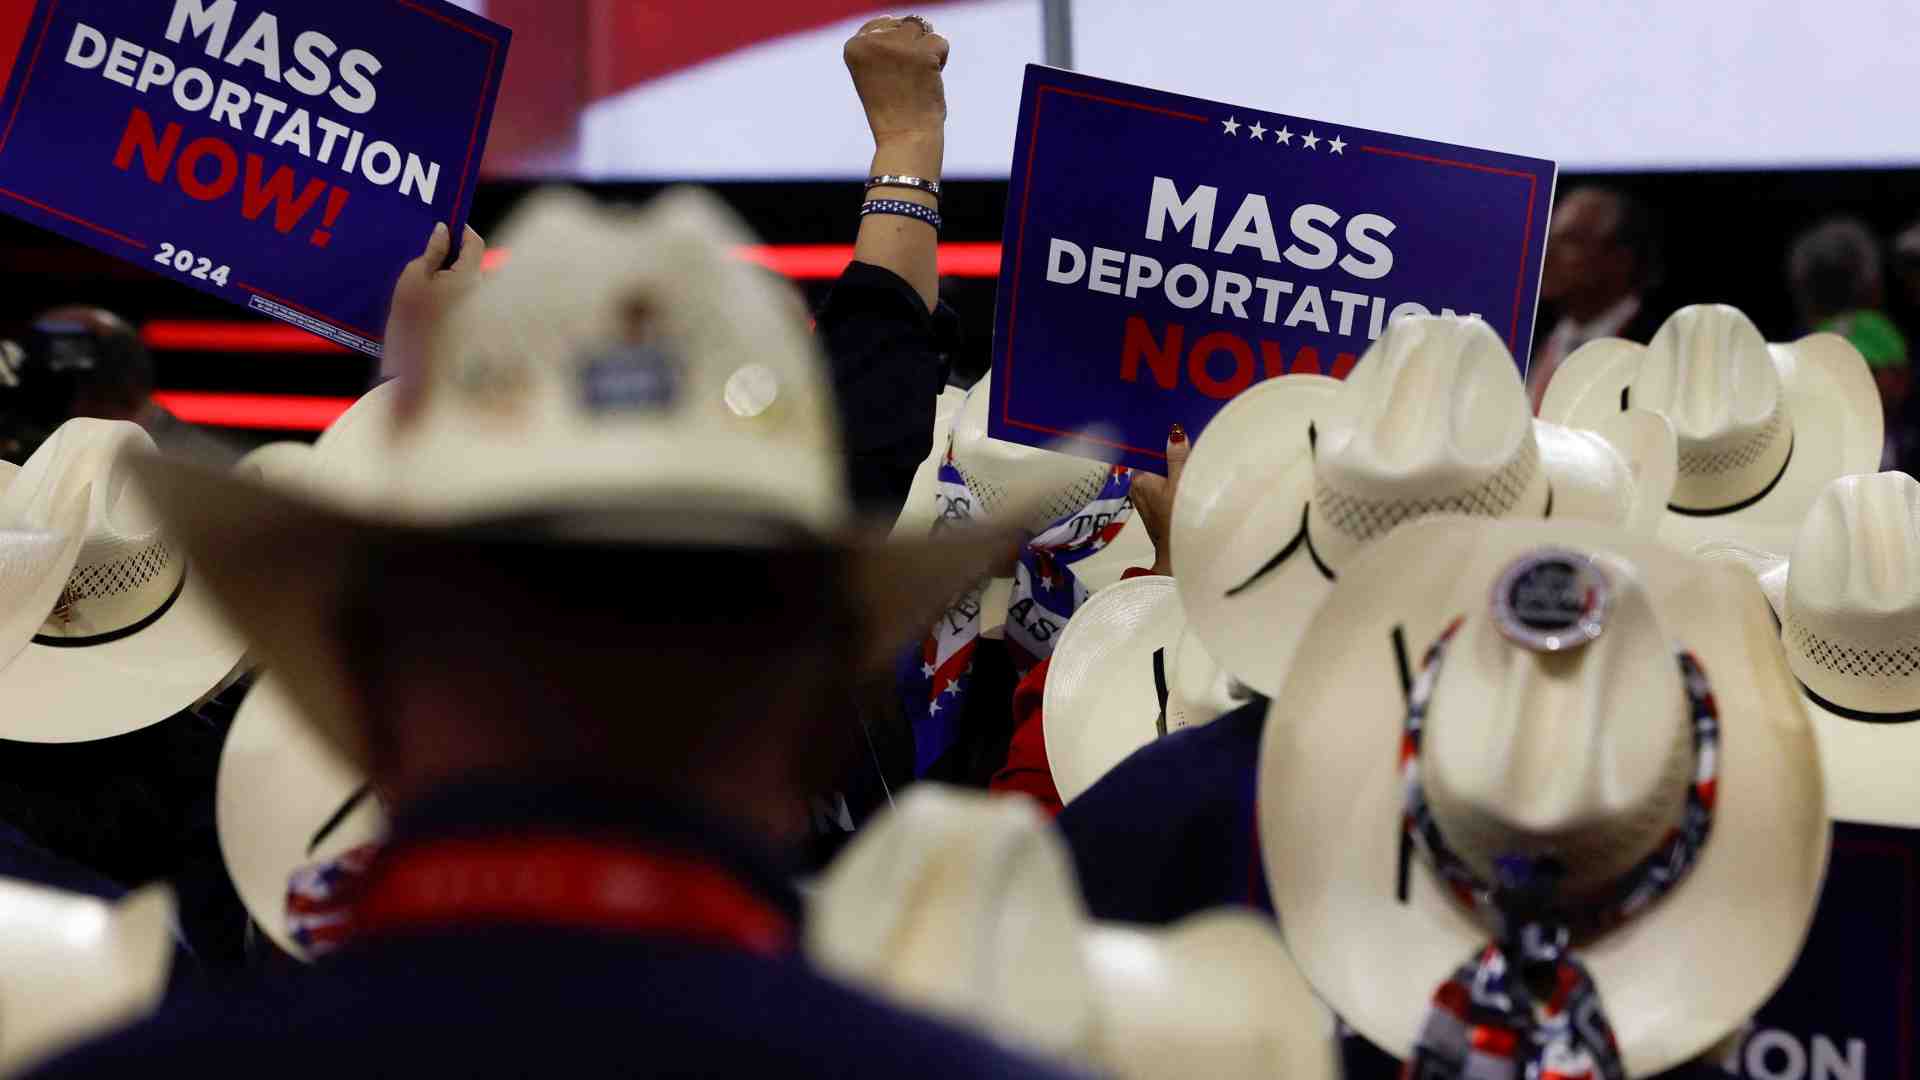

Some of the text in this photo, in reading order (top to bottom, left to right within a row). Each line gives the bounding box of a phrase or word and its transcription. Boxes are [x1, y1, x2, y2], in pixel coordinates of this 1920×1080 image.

[165, 0, 382, 114] MASS
[64, 22, 440, 205] DEPORTATION
[112, 106, 349, 248] NOW!
[1145, 176, 1397, 280] MASS
[153, 242, 232, 287] 2024
[1046, 238, 1482, 342] DEPORTATI
